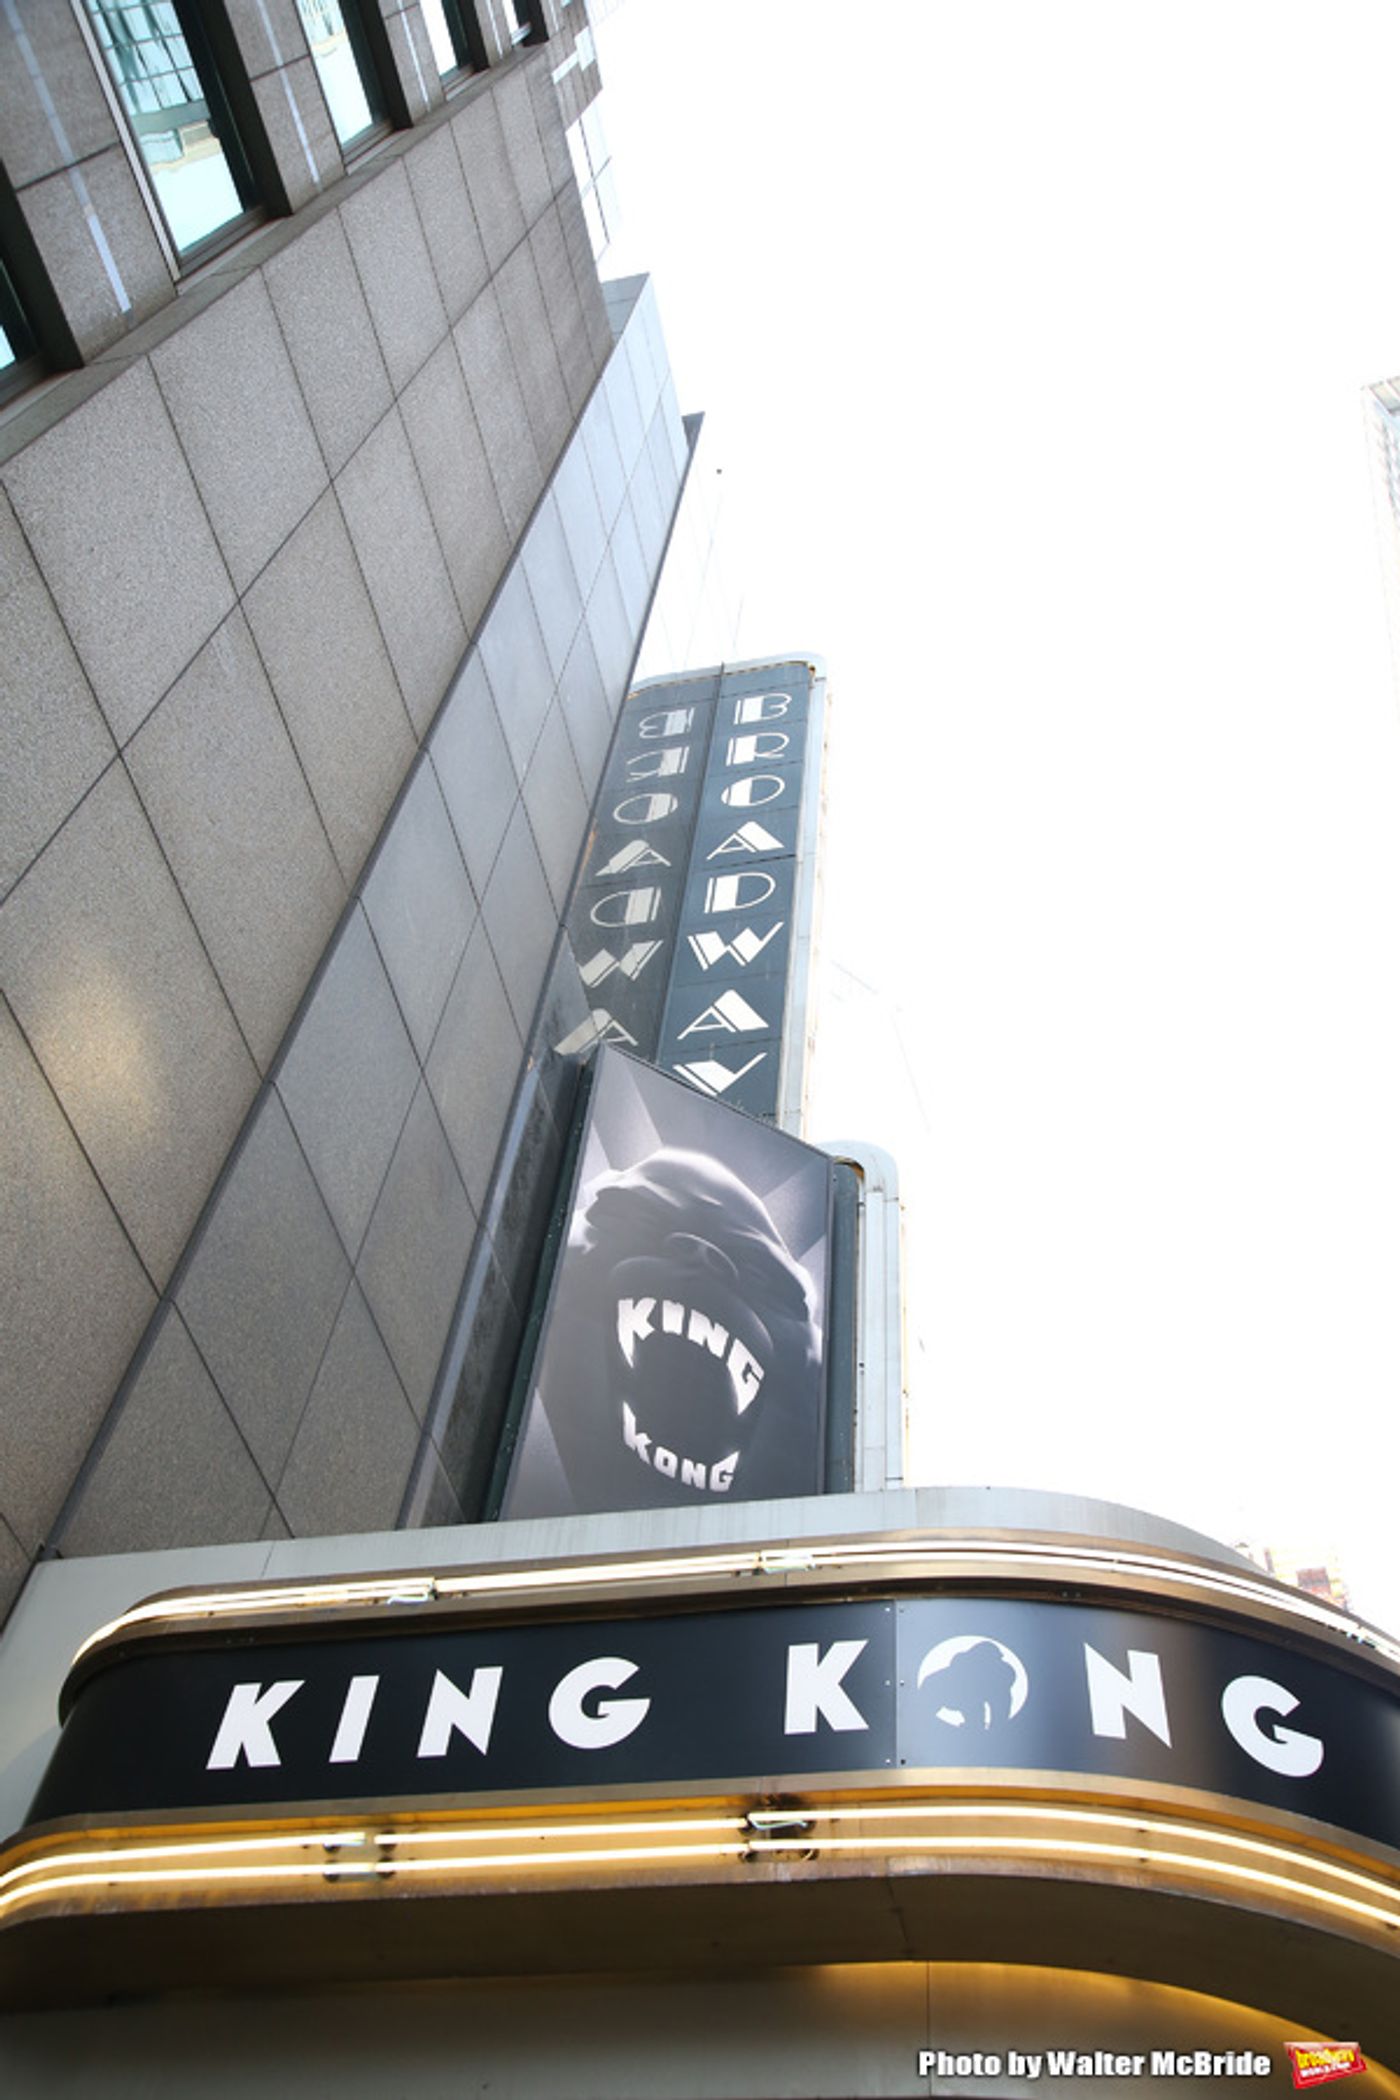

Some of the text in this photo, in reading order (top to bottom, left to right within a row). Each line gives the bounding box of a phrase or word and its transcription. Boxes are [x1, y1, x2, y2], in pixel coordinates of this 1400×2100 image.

[616, 1297, 765, 1416] KING
[622, 1400, 740, 1492] KONG
[205, 1635, 1323, 1777] KING KONG
